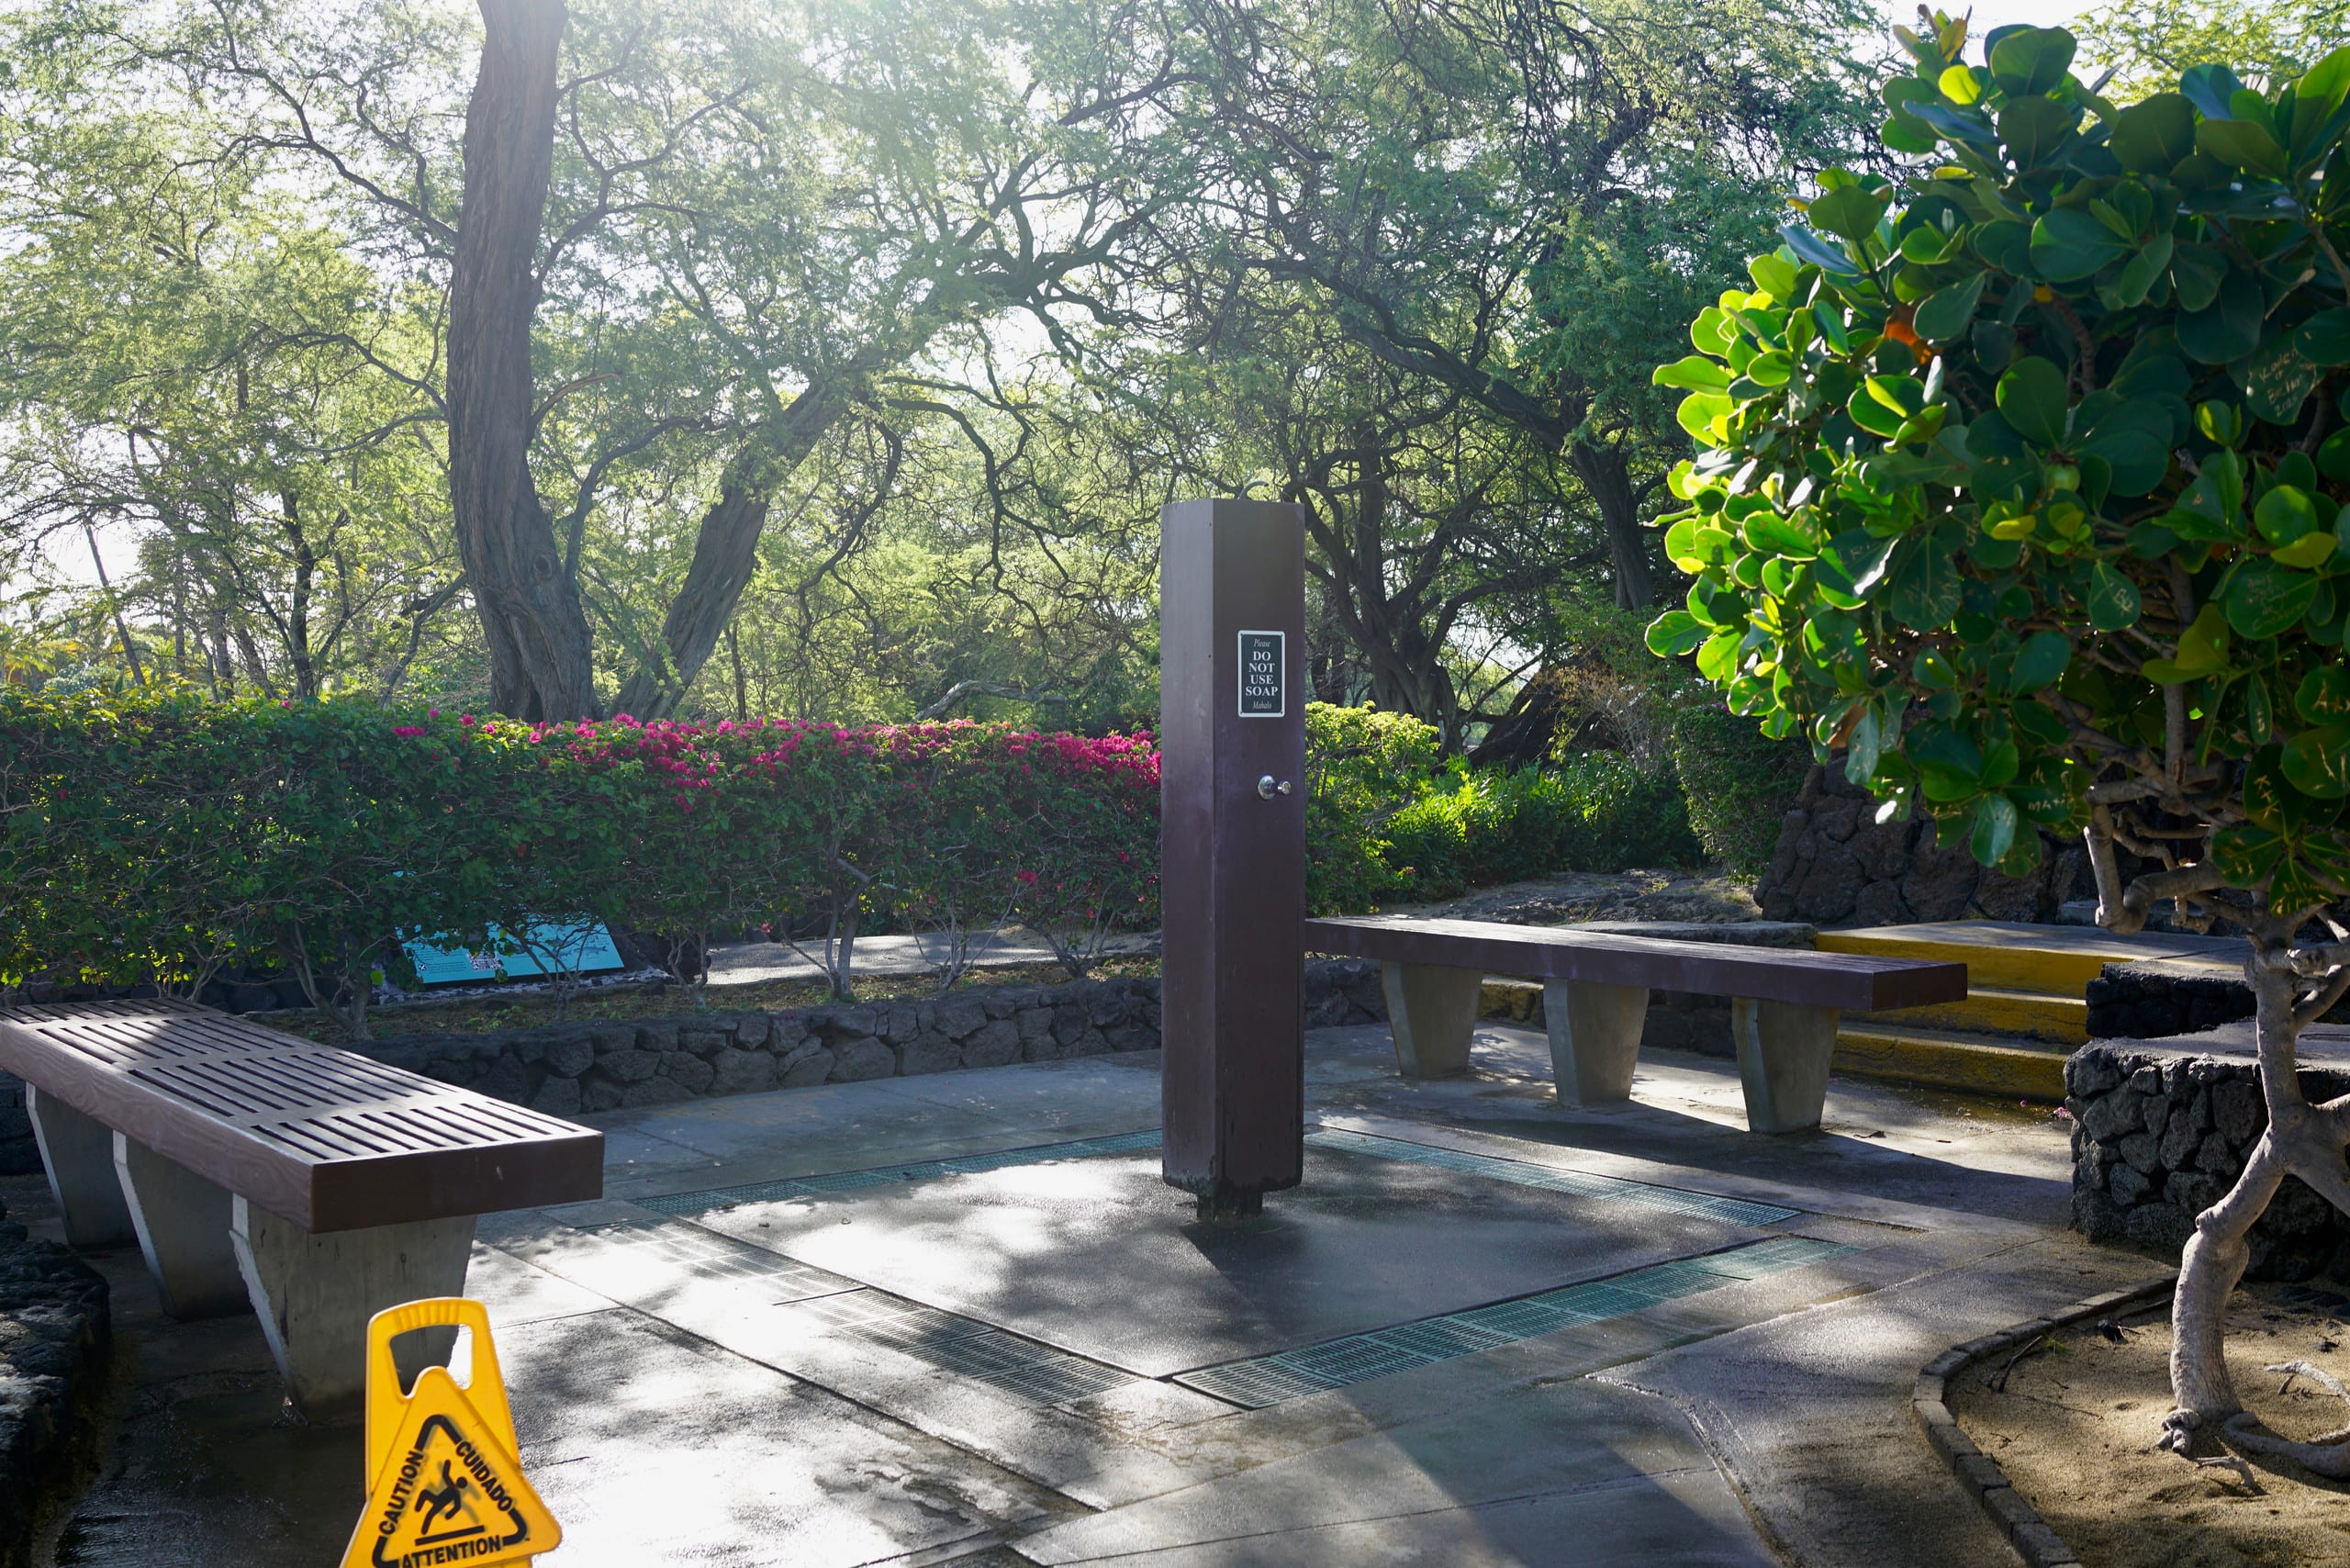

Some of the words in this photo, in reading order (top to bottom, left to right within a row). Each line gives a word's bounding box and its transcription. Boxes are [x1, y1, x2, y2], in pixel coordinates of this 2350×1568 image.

[1254, 638, 1270, 647] Please
[1253, 651, 1271, 661] DO
[1248, 663, 1275, 673] NOT
[1250, 675, 1273, 685] USE
[1245, 686, 1278, 696] SOAP
[1253, 700, 1272, 710] Mahalo
[455, 1441, 512, 1511] CUIDADO
[379, 1450, 423, 1535] CAUTION
[403, 1535, 501, 1568] ATTENTION
